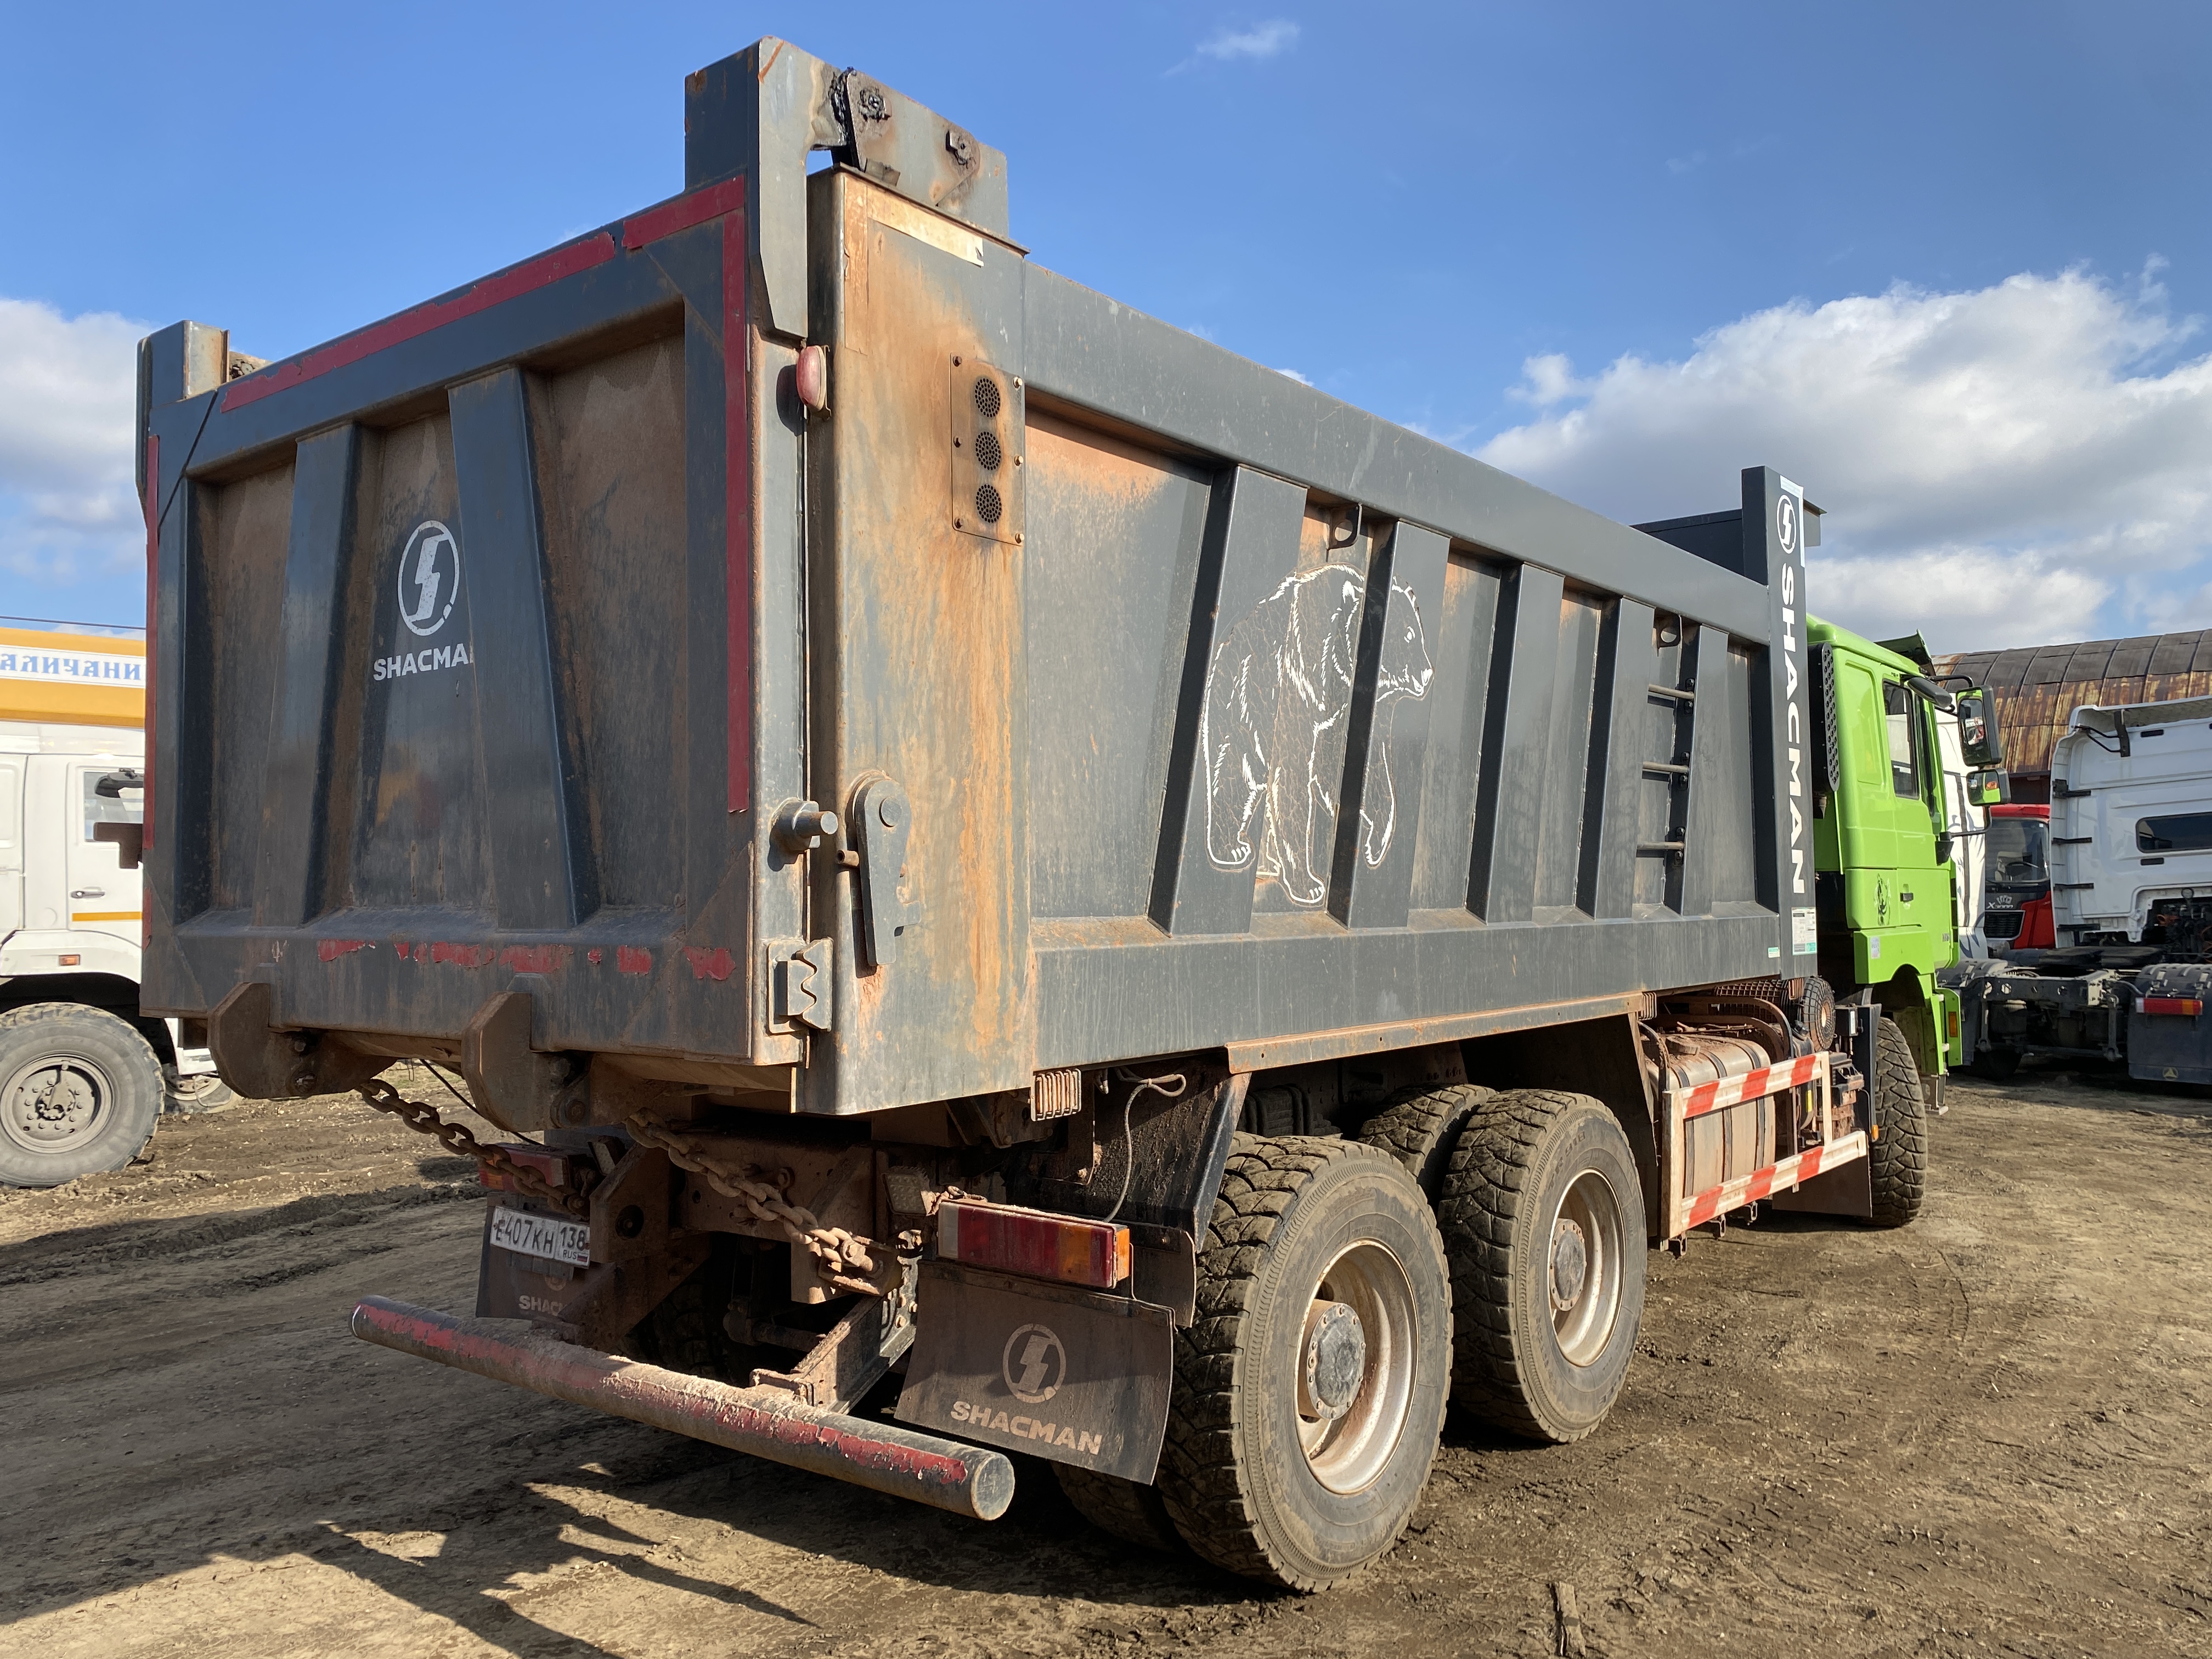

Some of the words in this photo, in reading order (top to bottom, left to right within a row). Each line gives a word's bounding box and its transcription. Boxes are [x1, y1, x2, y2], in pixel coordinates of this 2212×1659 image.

[373, 643, 474, 681] SHACMA
[1781, 563, 1805, 894] SHACMAN
[560, 1227, 586, 1251] 138
[563, 1249, 577, 1260] RUS
[518, 1295, 567, 1316] SHAC
[950, 1401, 1103, 1455] SHACMAN
